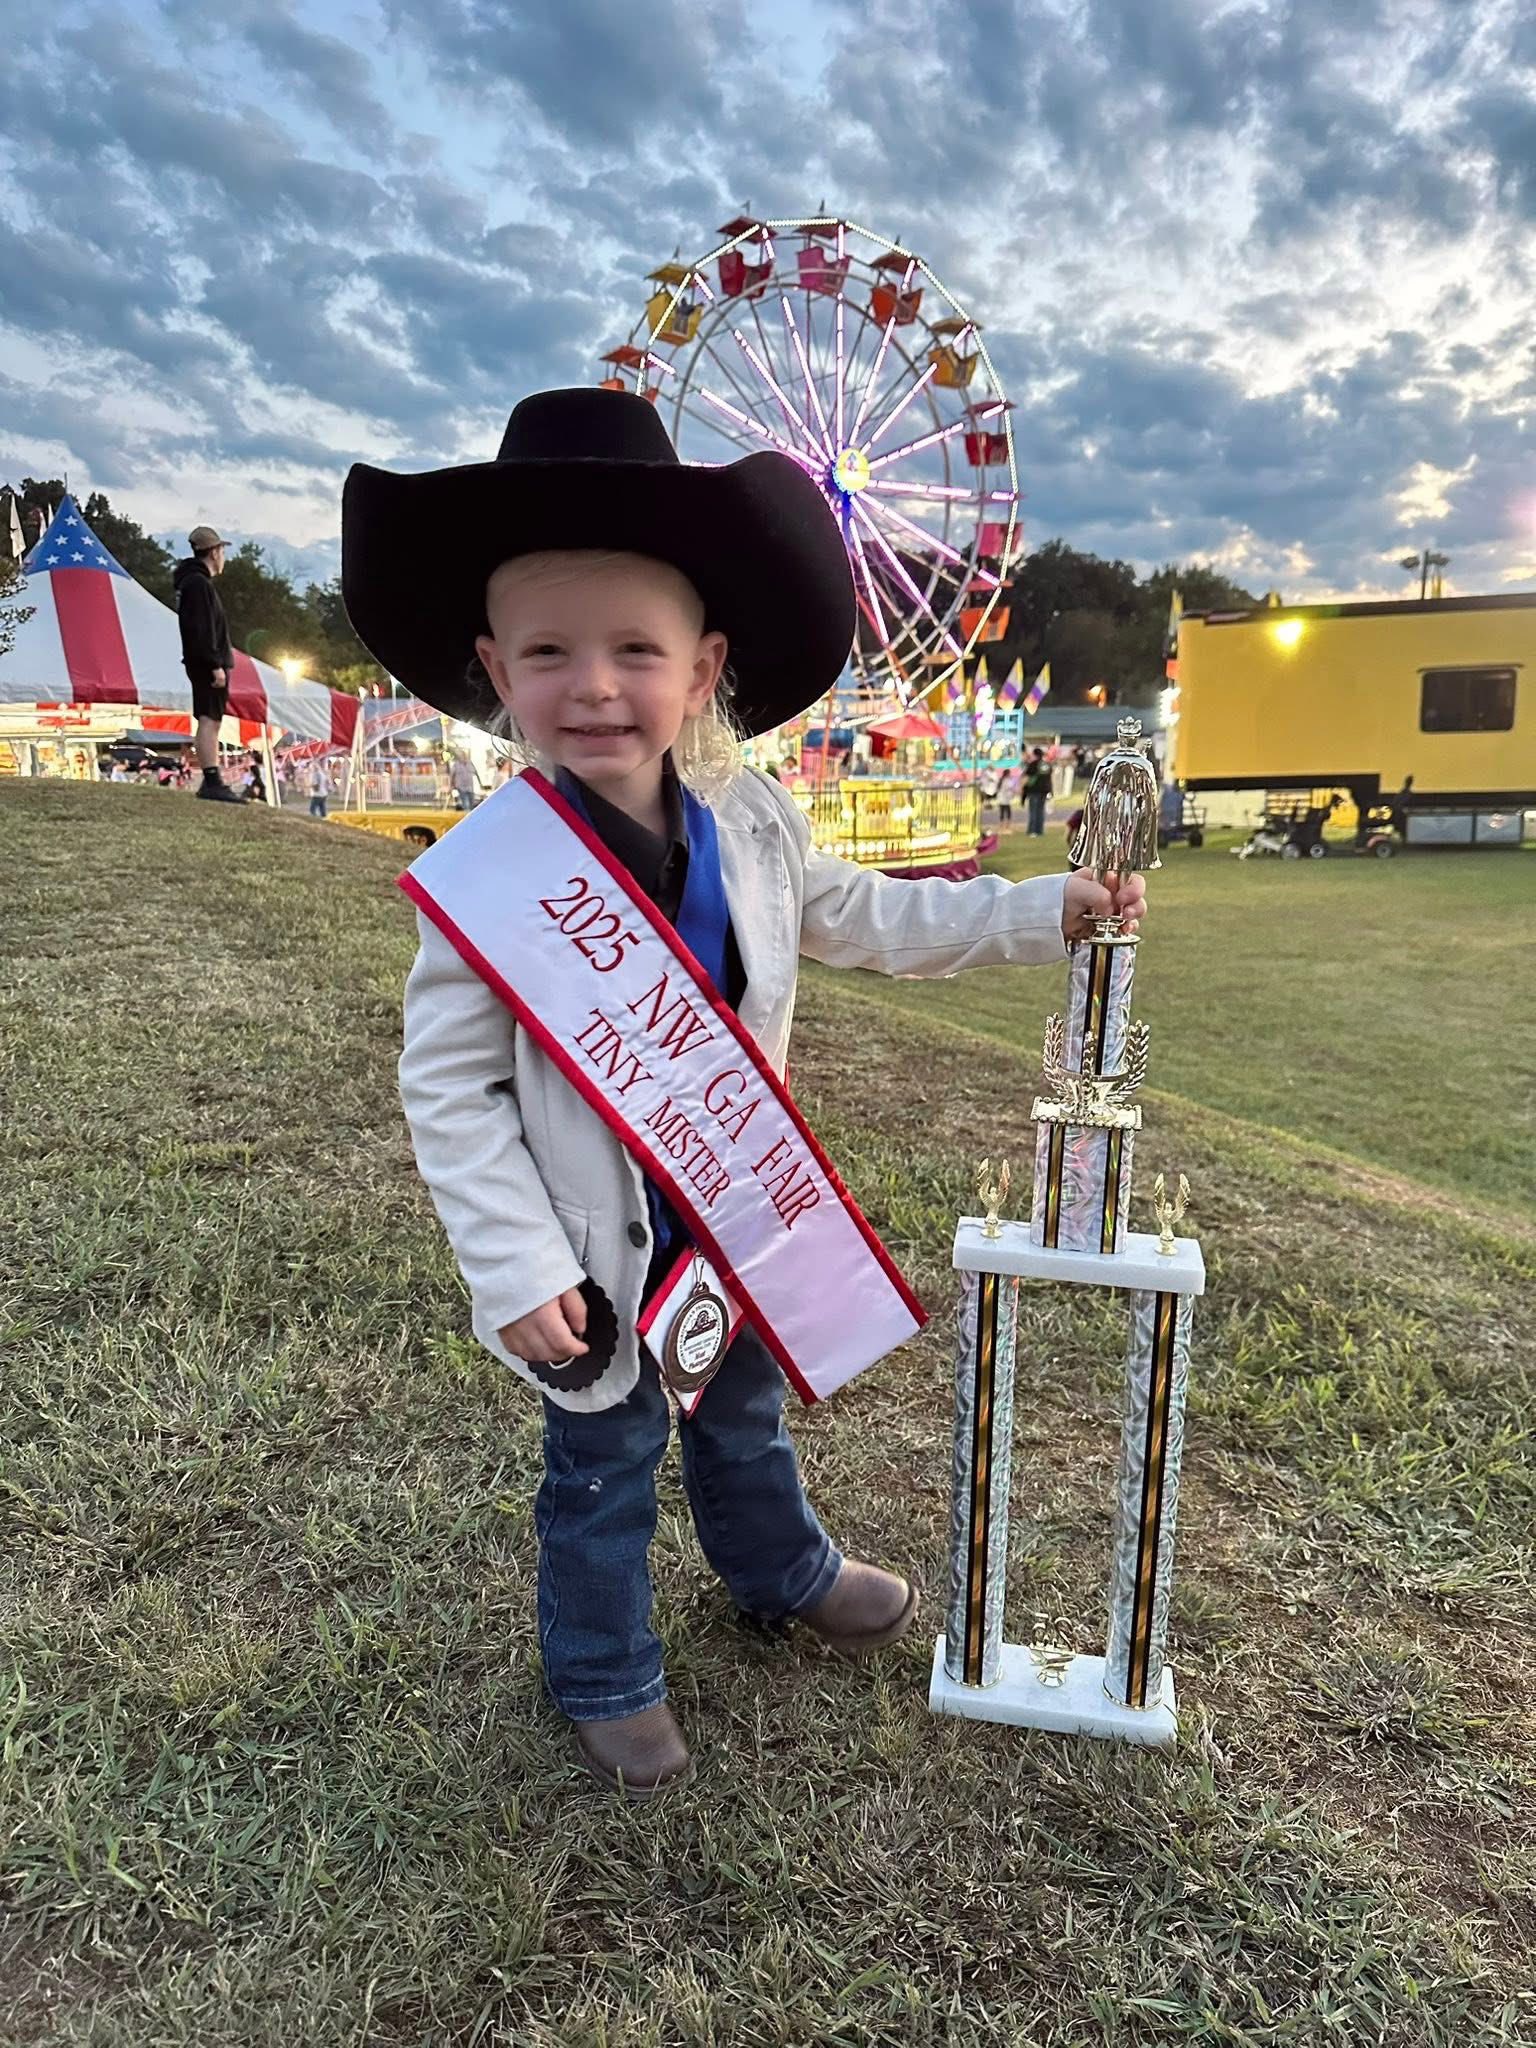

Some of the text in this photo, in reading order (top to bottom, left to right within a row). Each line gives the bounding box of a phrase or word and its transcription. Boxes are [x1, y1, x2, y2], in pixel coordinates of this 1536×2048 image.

[538, 877, 821, 1231] 2025 NW GA FAIR
[573, 1008, 653, 1096] TINY
[644, 1097, 731, 1208] MISTER
